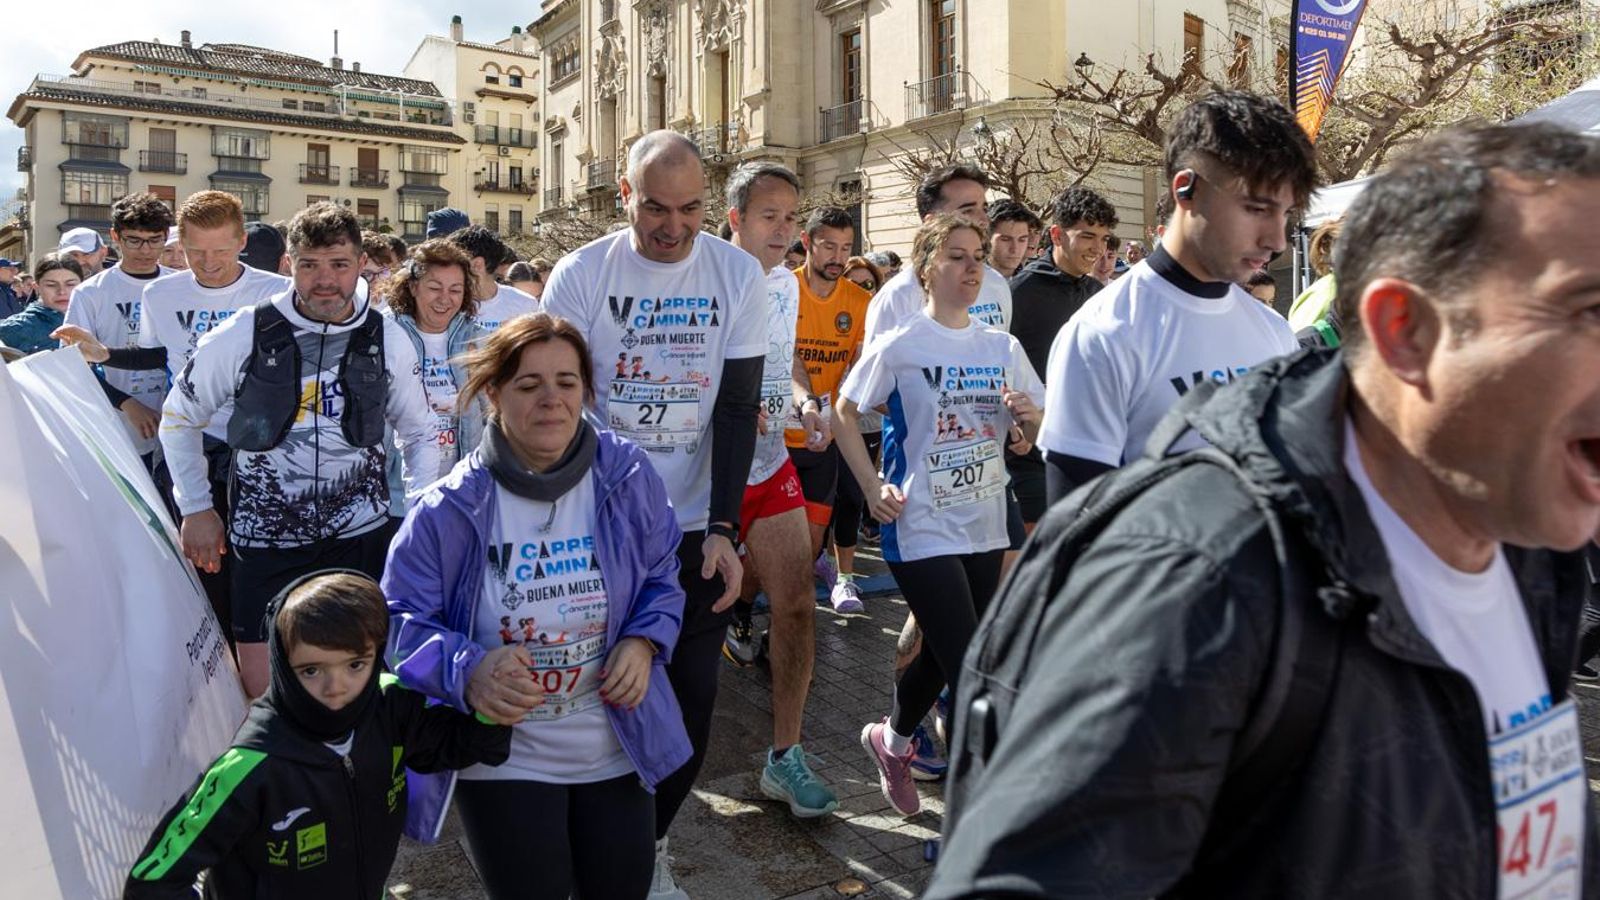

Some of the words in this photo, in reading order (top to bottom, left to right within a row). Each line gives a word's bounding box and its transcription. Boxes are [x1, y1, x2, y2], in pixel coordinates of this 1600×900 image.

[640, 296, 719, 313] CARRERA
[634, 312, 719, 329] CAMINATA
[640, 333, 666, 346] BUENA
[669, 332, 706, 345] MUERTE
[638, 404, 668, 425] 27
[951, 463, 984, 488] 207
[526, 585, 565, 603] BUENA
